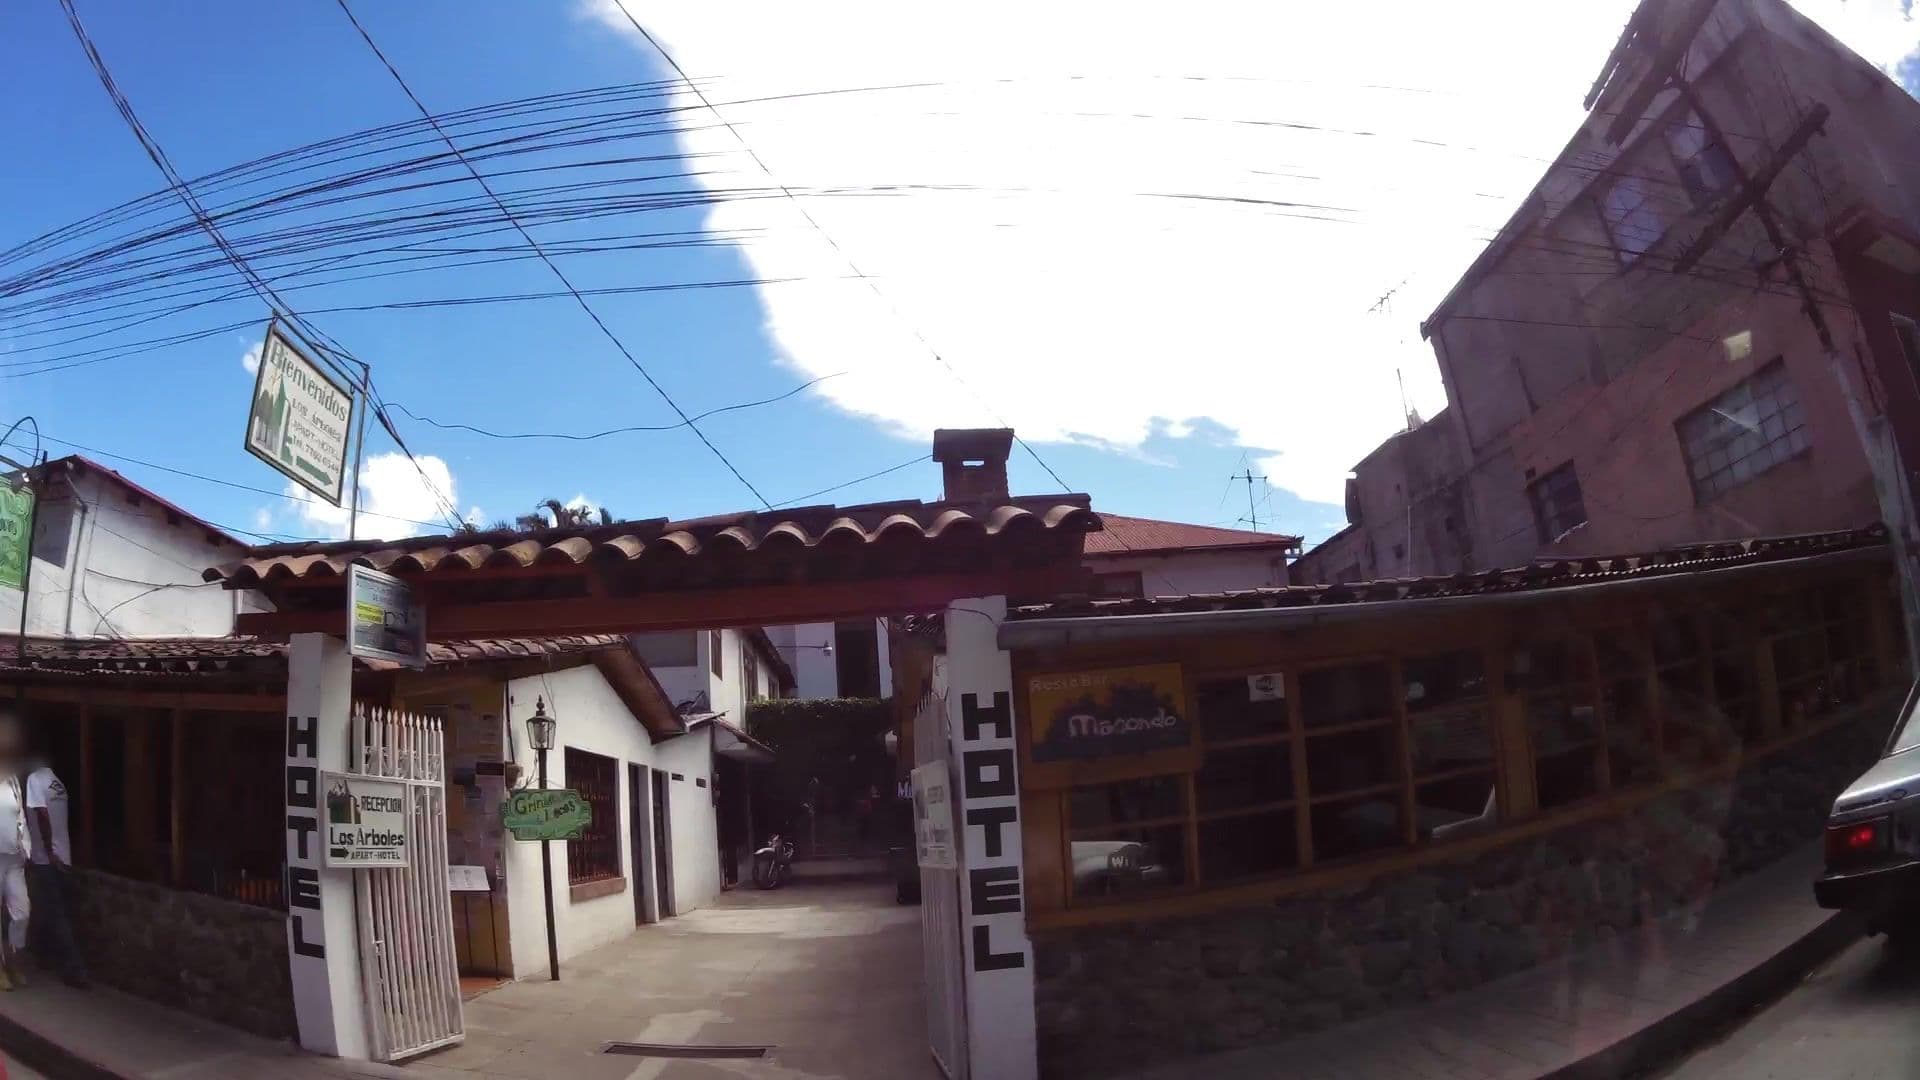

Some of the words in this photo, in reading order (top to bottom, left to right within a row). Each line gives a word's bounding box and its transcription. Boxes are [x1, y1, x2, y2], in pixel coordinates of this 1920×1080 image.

[270, 341, 347, 422] Bienvenidos
[1068, 707, 1177, 737] Macondo
[287, 716, 325, 959] HOTEL
[330, 826, 354, 846] Los
[356, 827, 405, 846] Arboles
[351, 850, 401, 860] APART-HOTEL
[961, 690, 1025, 972] HOTEL
